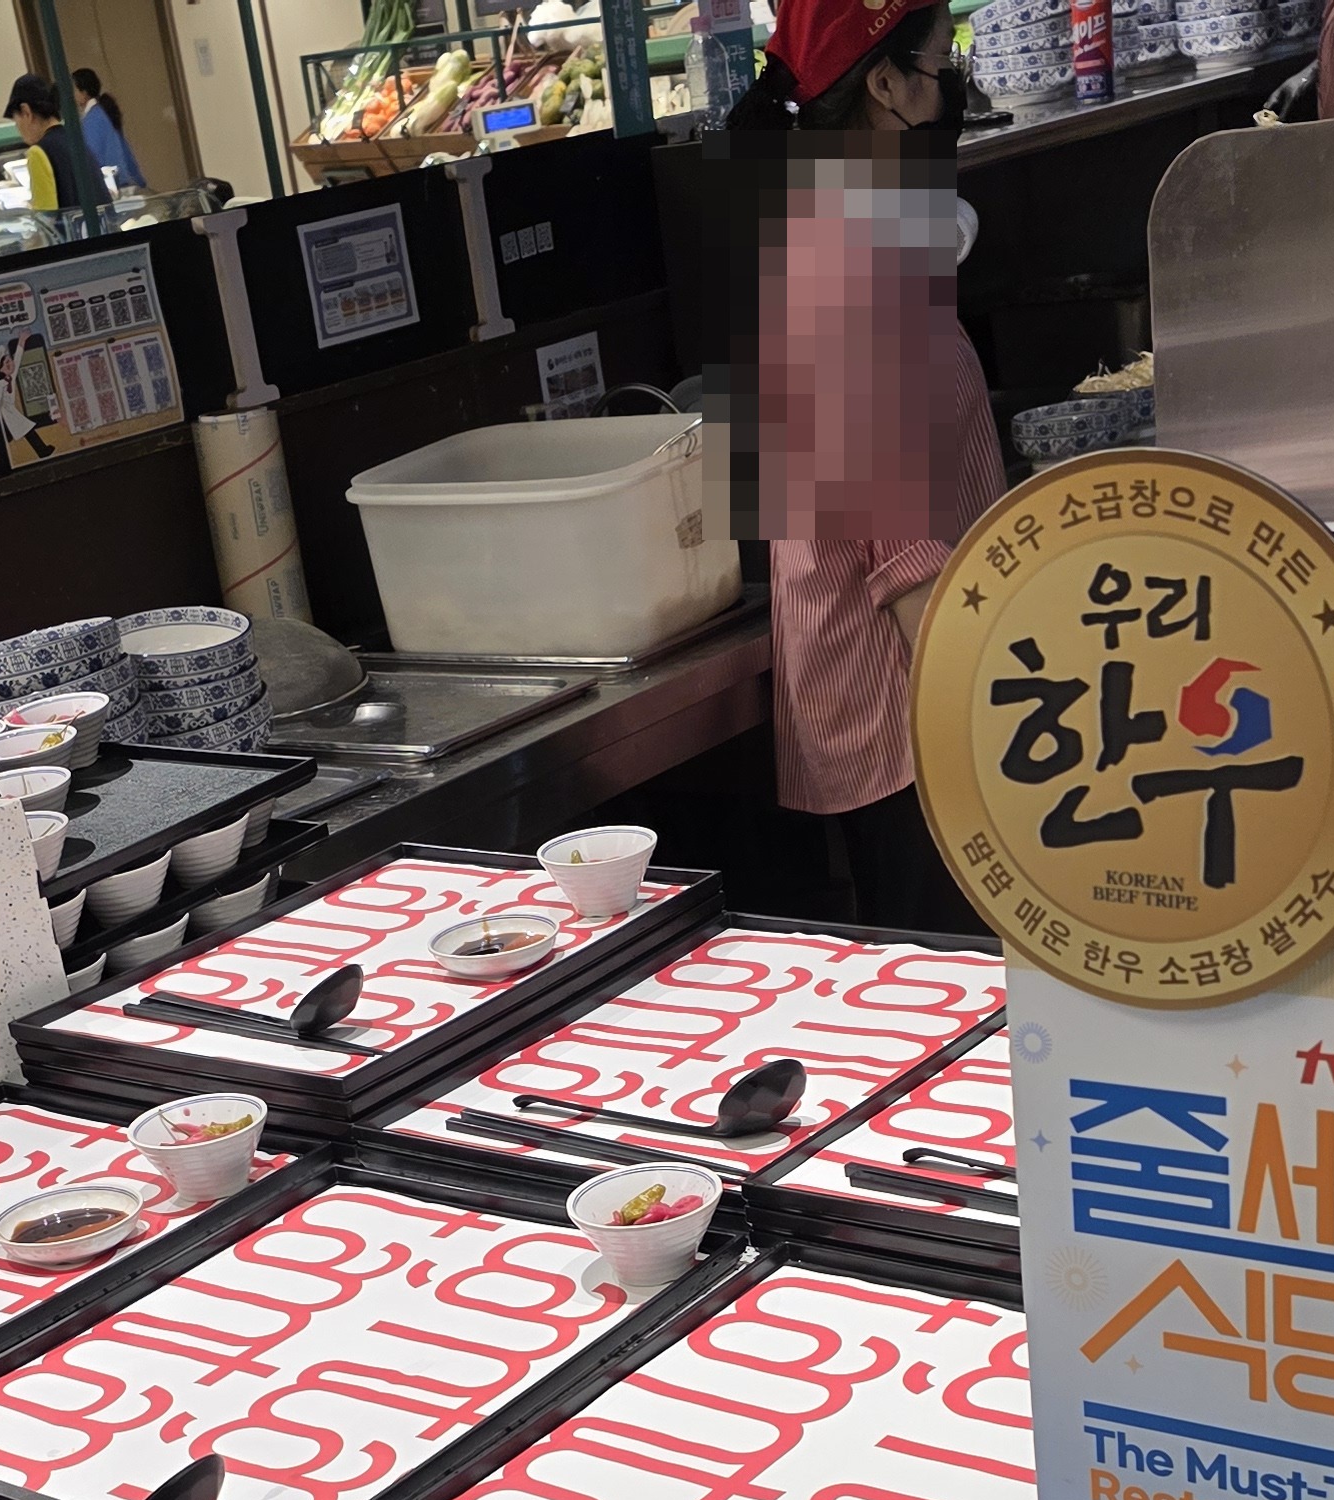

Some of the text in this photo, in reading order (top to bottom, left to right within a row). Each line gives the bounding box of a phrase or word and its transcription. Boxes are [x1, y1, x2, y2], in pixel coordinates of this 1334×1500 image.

[985, 480, 1317, 594] 한우 소곱창으로 만든
[1081, 563, 1212, 650] 우리
[990, 637, 1304, 889] 한우
[962, 831, 1015, 898] 땀땀
[1014, 897, 1072, 956] 매운
[1083, 940, 1144, 985] 한우
[1158, 940, 1254, 986] 소곱창
[1092, 886, 1199, 912] BEEF TRIPE
[1105, 869, 1186, 892] KOREAN
[1084, 1425, 1174, 1478] The
